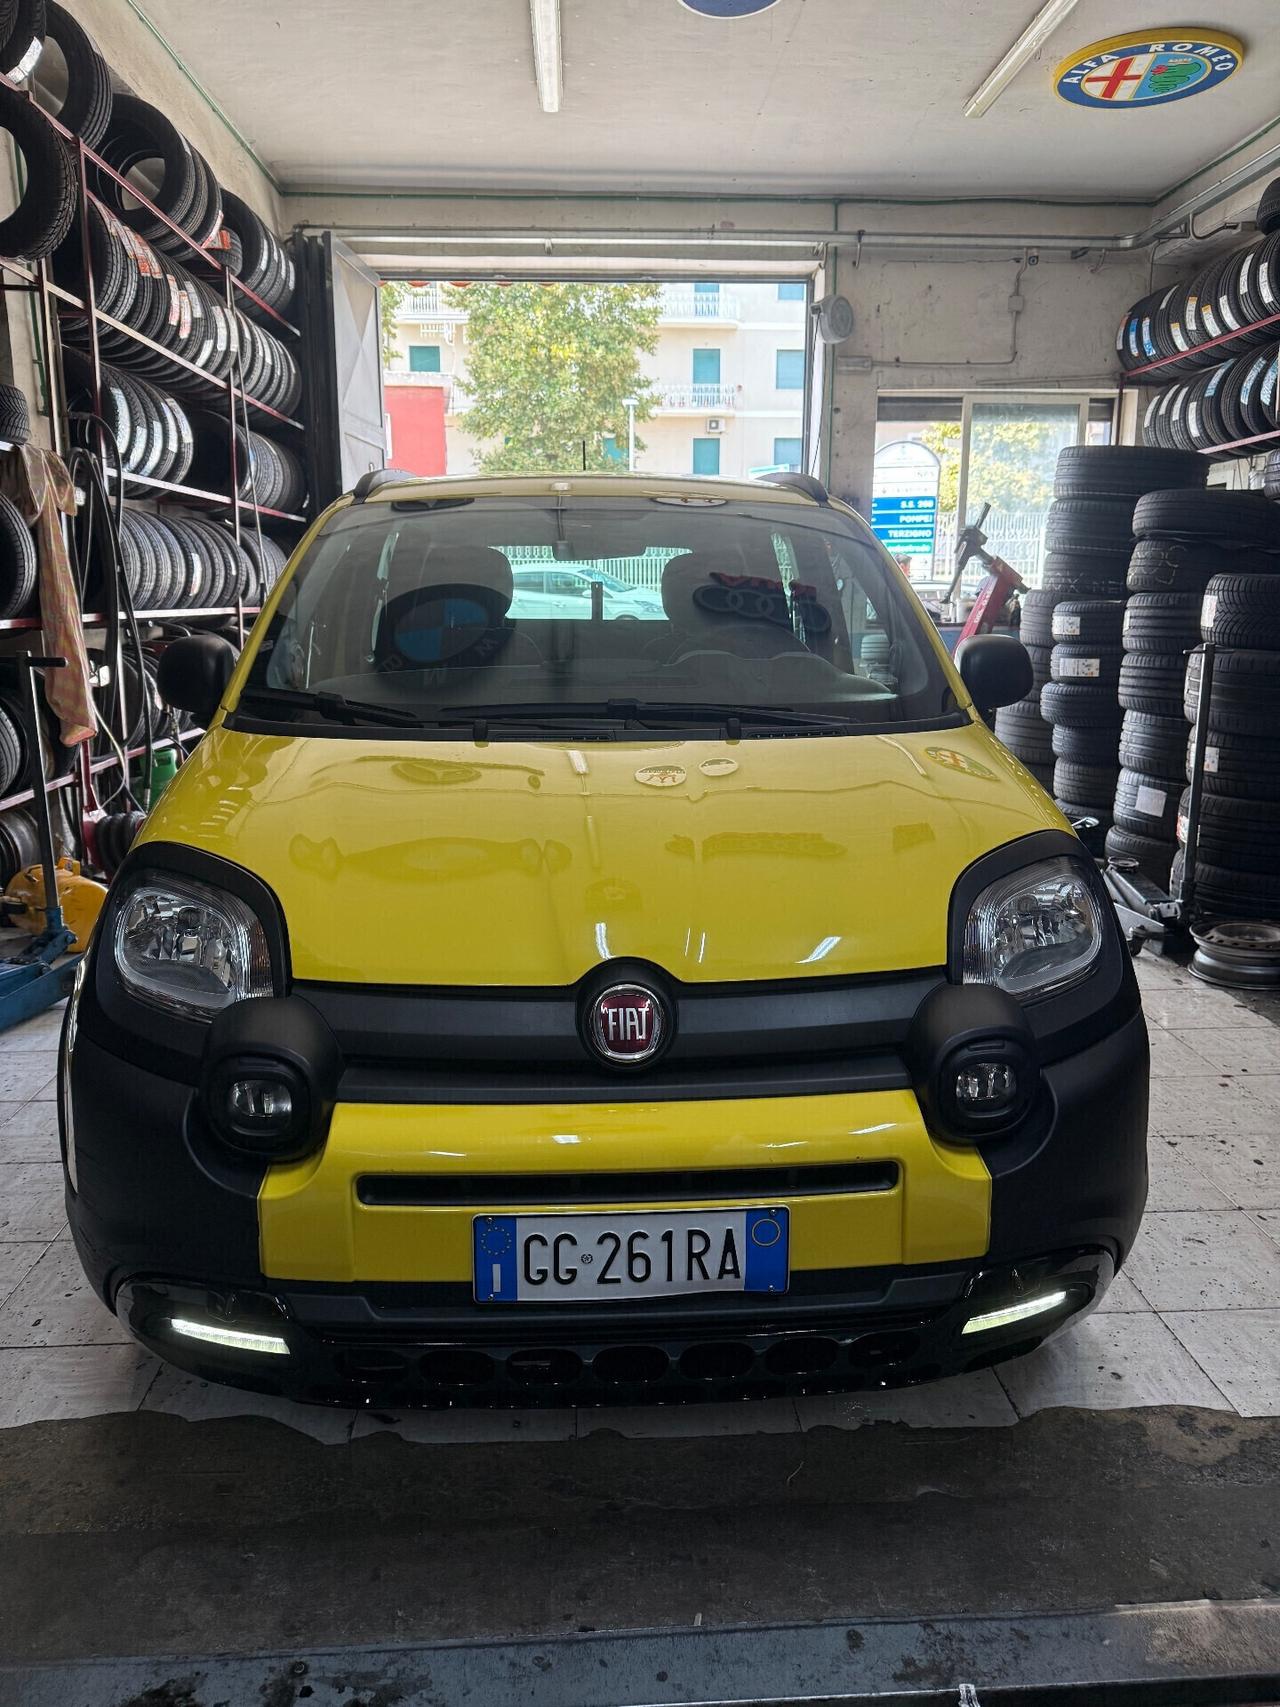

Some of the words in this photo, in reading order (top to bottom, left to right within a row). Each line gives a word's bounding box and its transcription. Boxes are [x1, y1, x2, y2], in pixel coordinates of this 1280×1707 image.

[1062, 53, 1120, 84] ALFA
[1148, 43, 1235, 72] ROMEO
[608, 1007, 650, 1041] FIAT
